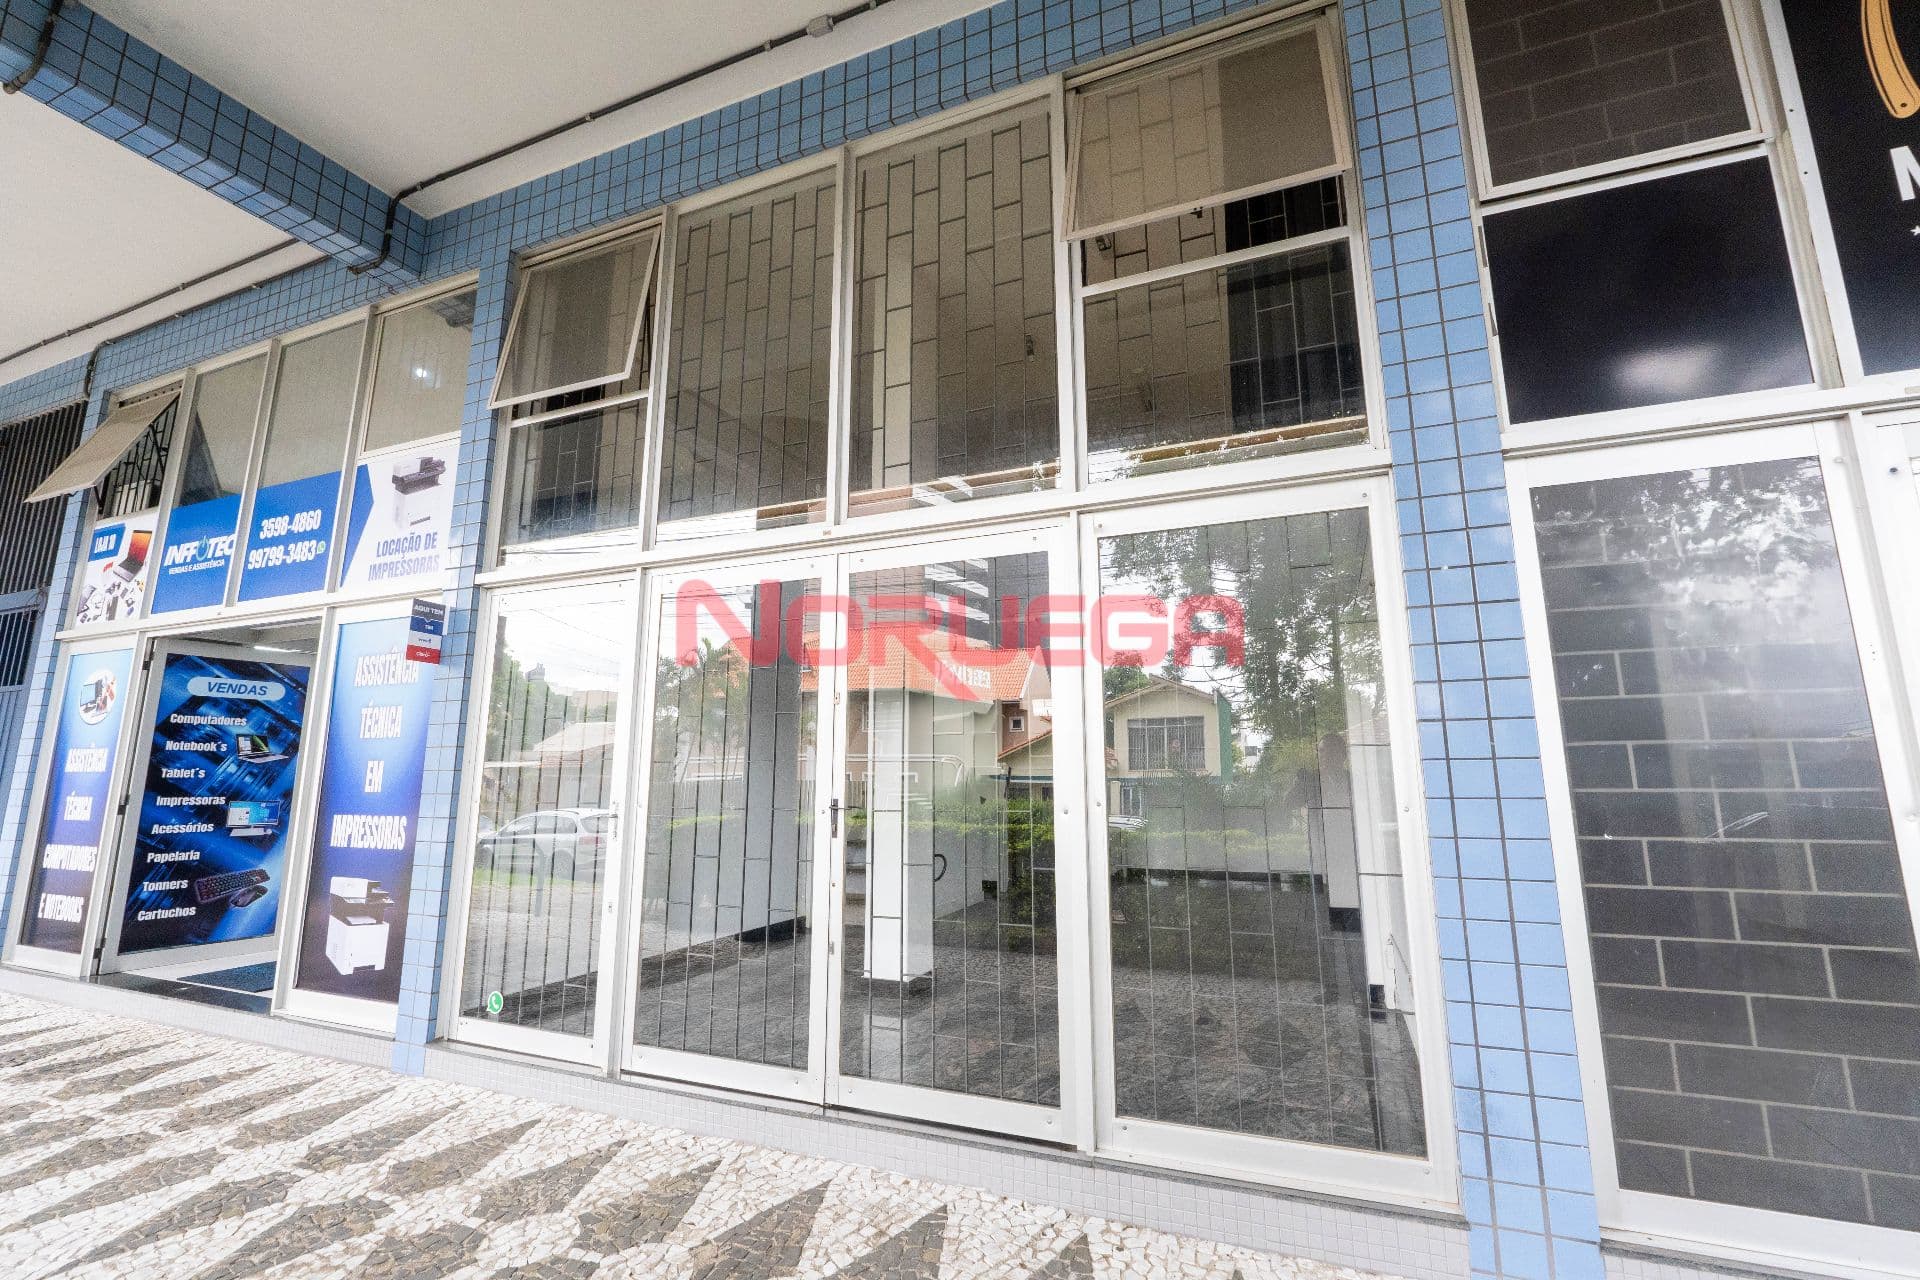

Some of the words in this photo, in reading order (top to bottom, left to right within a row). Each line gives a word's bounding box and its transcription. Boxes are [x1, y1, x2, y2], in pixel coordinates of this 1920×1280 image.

[259, 509, 322, 540] 3598-4860
[247, 540, 317, 570] 99799-3483
[376, 532, 422, 559] LOCAÇÃO
[423, 532, 438, 550] DE
[368, 555, 440, 581] IMPRESSORAS
[414, 604, 430, 613] AQUI
[354, 648, 420, 687] ASSISTÊNCIA
[207, 681, 268, 696] VENDAS
[170, 713, 247, 726] Computadores
[360, 699, 403, 739] TÉCNICA
[365, 760, 385, 793] EM
[156, 796, 226, 807] Impressoras
[152, 822, 215, 835] Acessórios
[330, 814, 408, 851] IMPRESSORAS
[42, 844, 98, 873] COMPUTADORES
[147, 850, 200, 863] Papelaria
[143, 879, 189, 892] Tonners
[37, 892, 46, 919] E
[43, 893, 84, 923] NOTEBOOKS
[137, 906, 197, 921] Cartuchos
